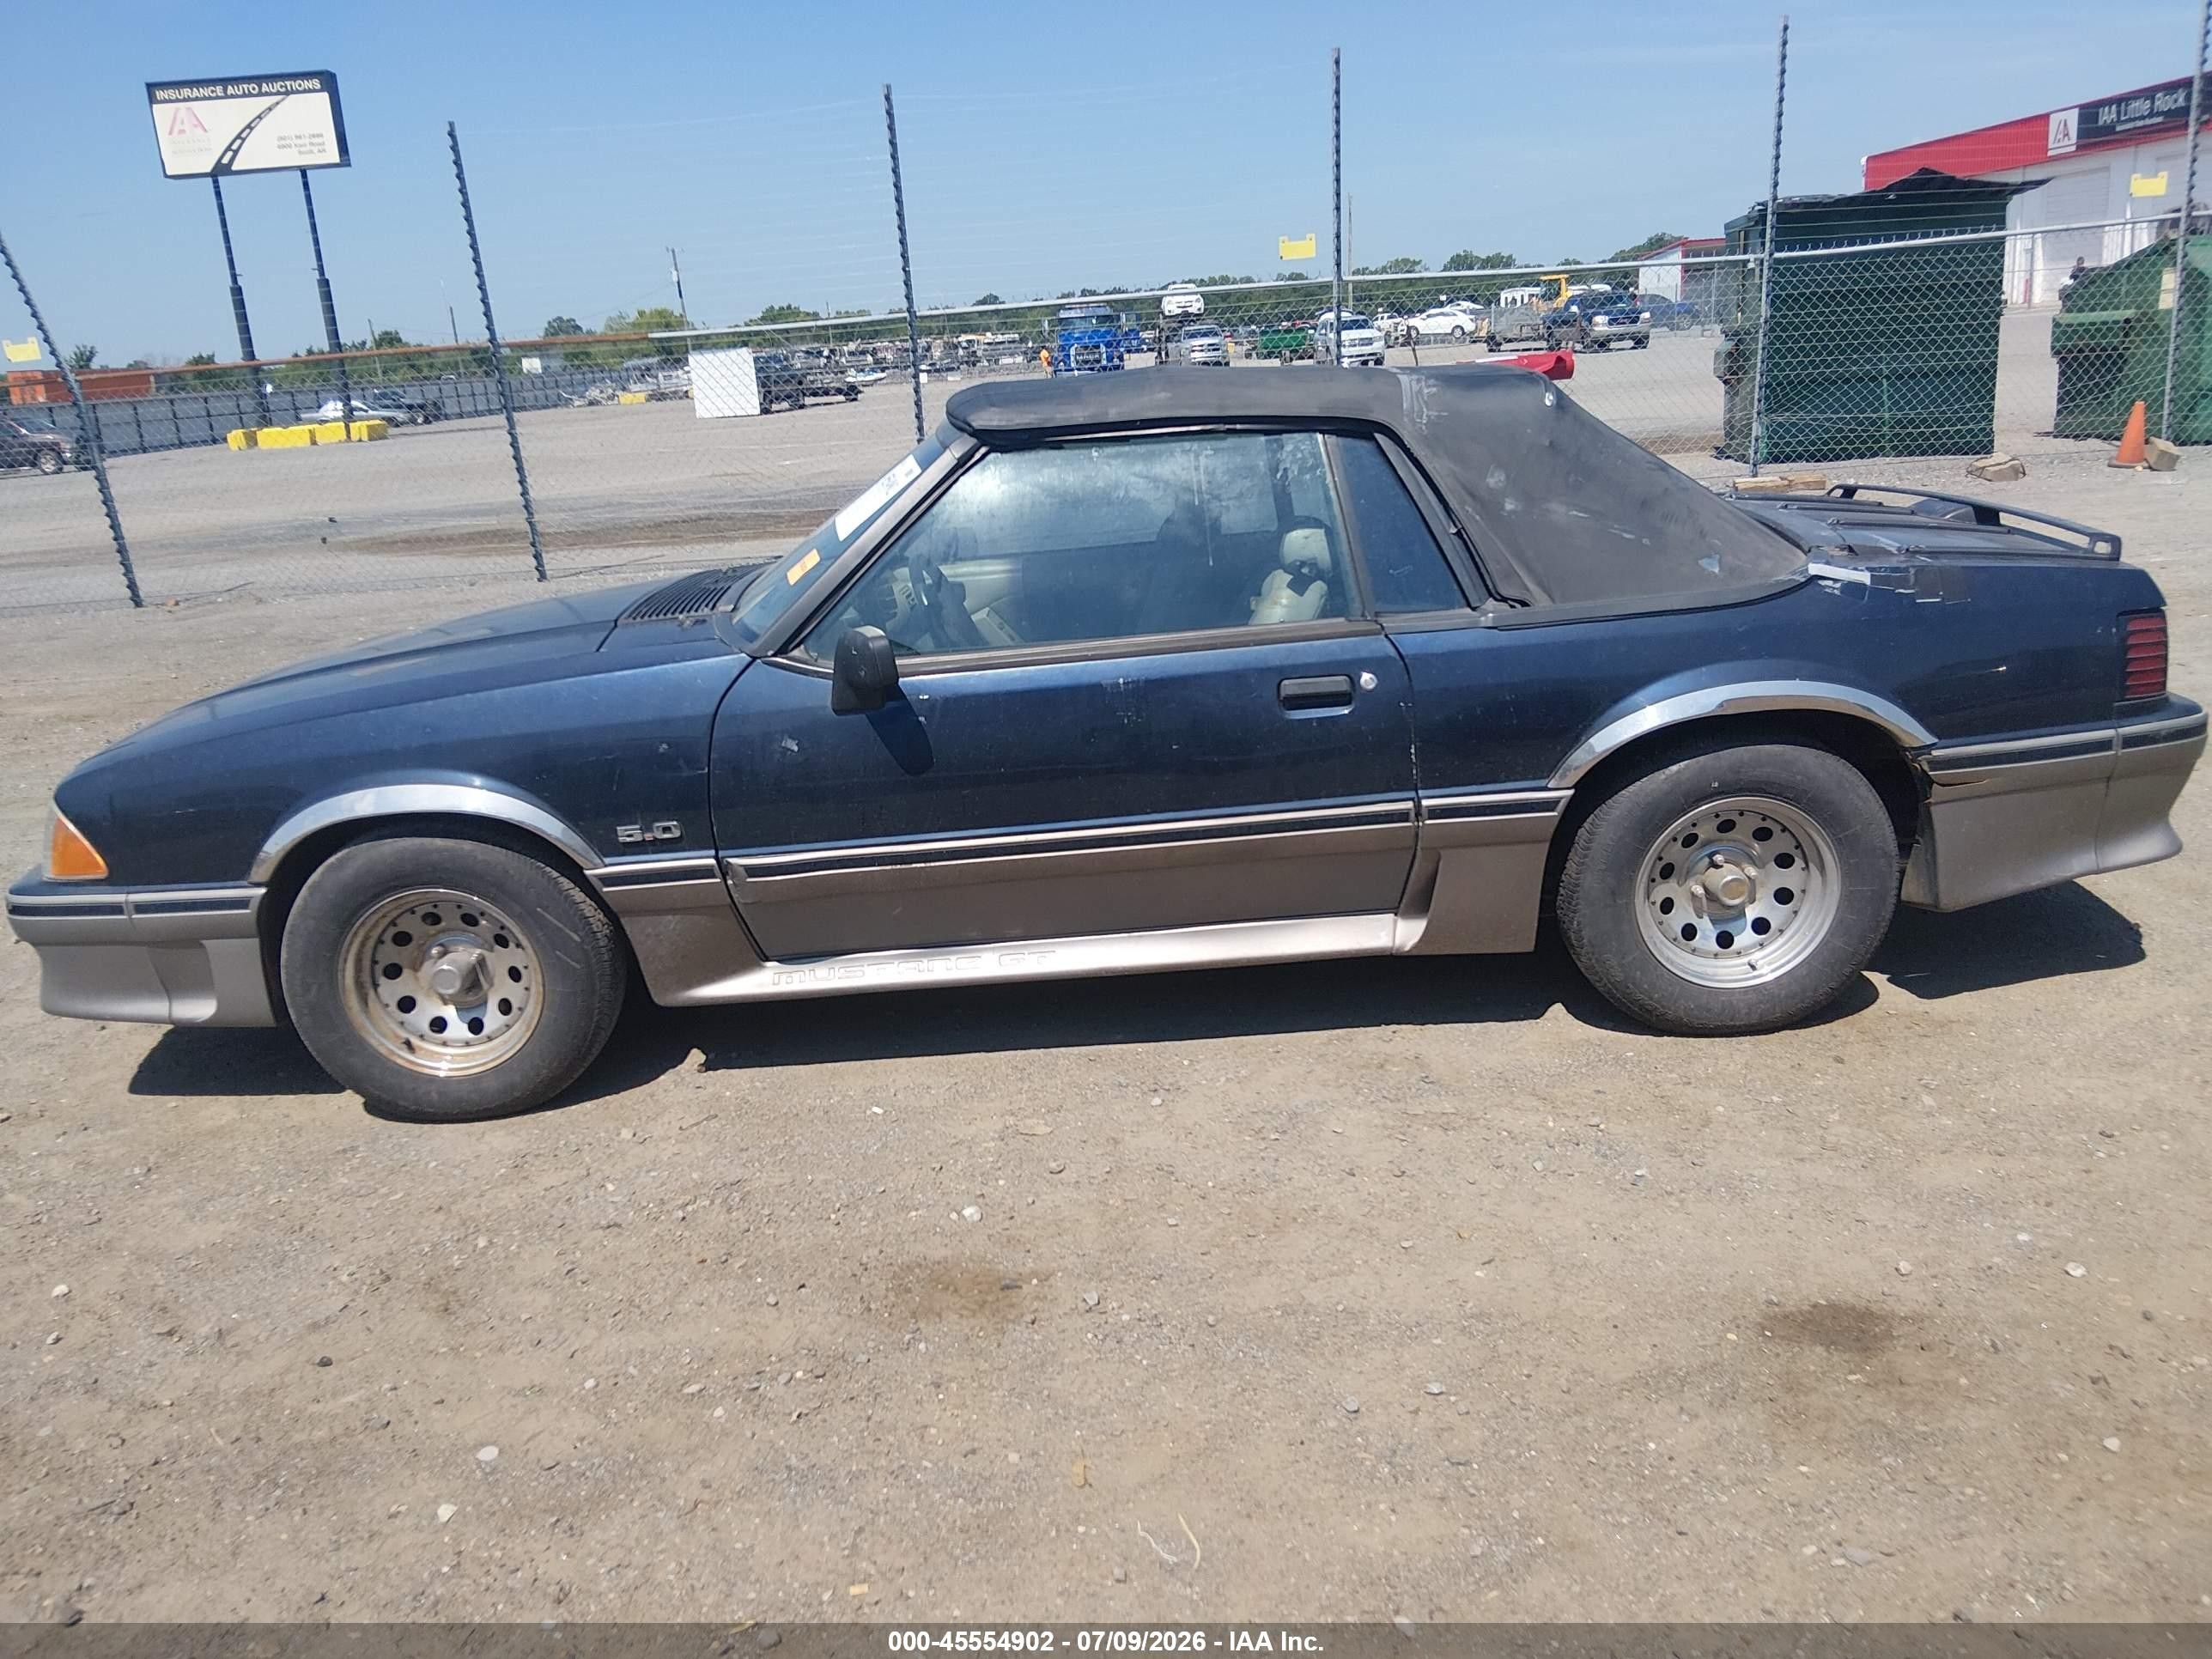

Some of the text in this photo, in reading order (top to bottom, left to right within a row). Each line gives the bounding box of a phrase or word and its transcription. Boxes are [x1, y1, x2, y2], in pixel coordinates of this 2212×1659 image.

[155, 78, 322, 100] INSURANCE AUTO AUCTIONS
[2098, 104, 2118, 125] IAA
[2120, 96, 2151, 120] Little
[2154, 88, 2188, 113] Rock
[617, 821, 681, 842] 5.0
[773, 950, 1056, 986] MUSTANG GT
